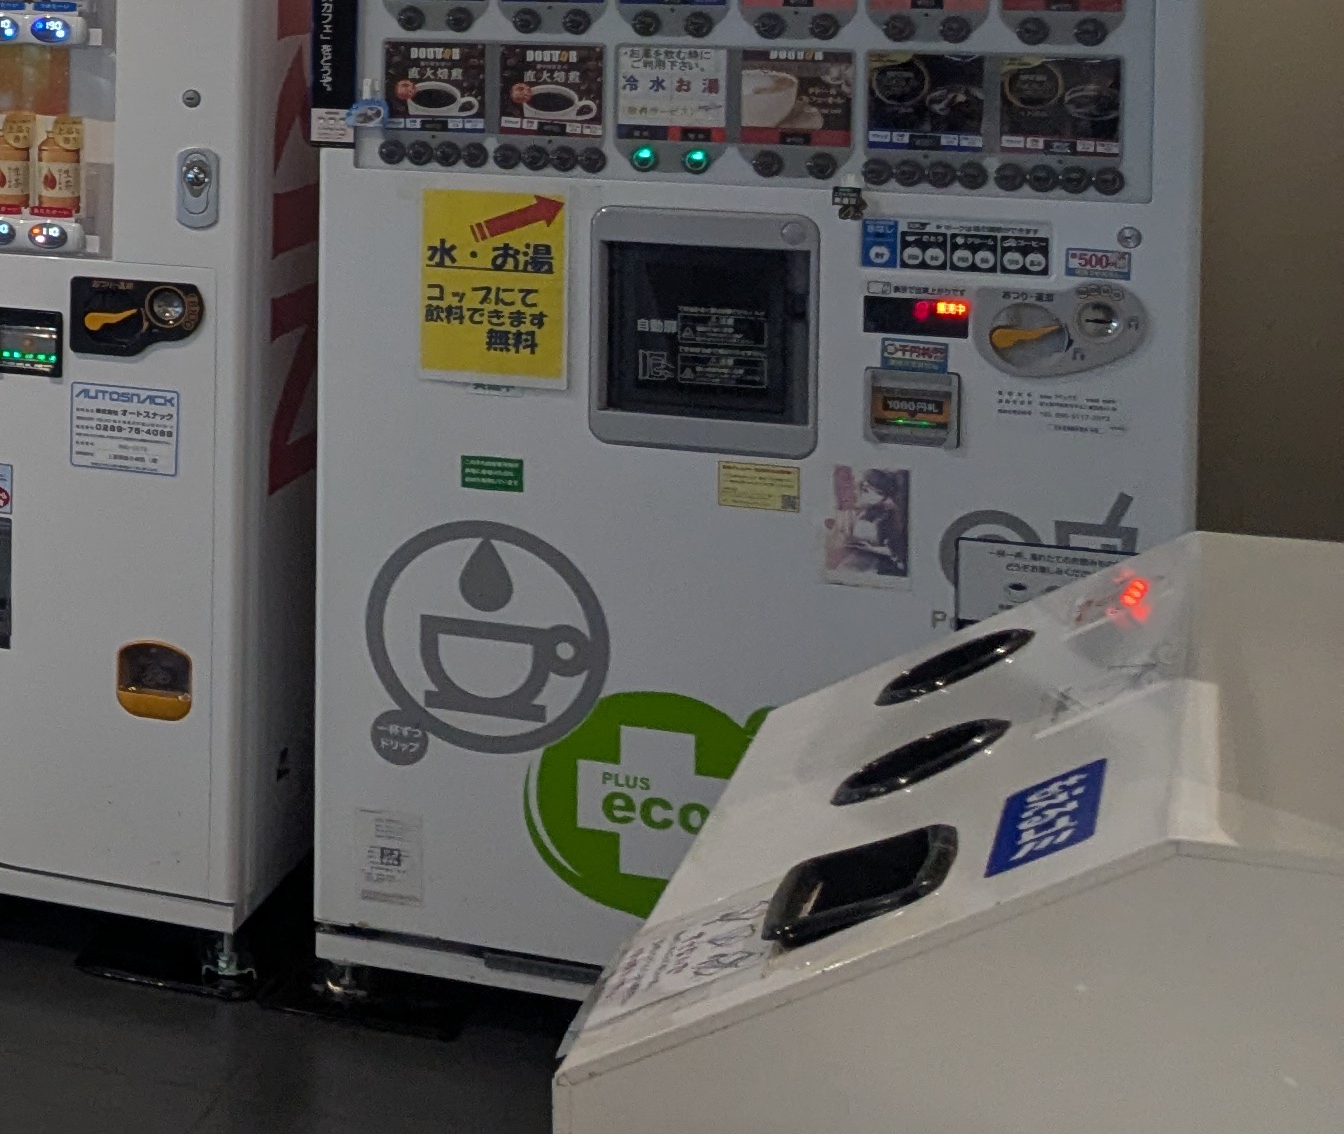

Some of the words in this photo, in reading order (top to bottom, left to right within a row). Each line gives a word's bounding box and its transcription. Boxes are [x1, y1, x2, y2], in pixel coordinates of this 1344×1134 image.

[622, 74, 666, 91] 冷水
[675, 77, 720, 95] お湯
[1016, 238, 1047, 247] コーヒー
[425, 237, 555, 274] 水・お湯
[425, 283, 539, 307] コップにて
[424, 305, 548, 329] 飲料できます
[485, 329, 539, 355] 無料
[379, 739, 423, 754] ドリップ
[601, 771, 651, 791] PLUS
